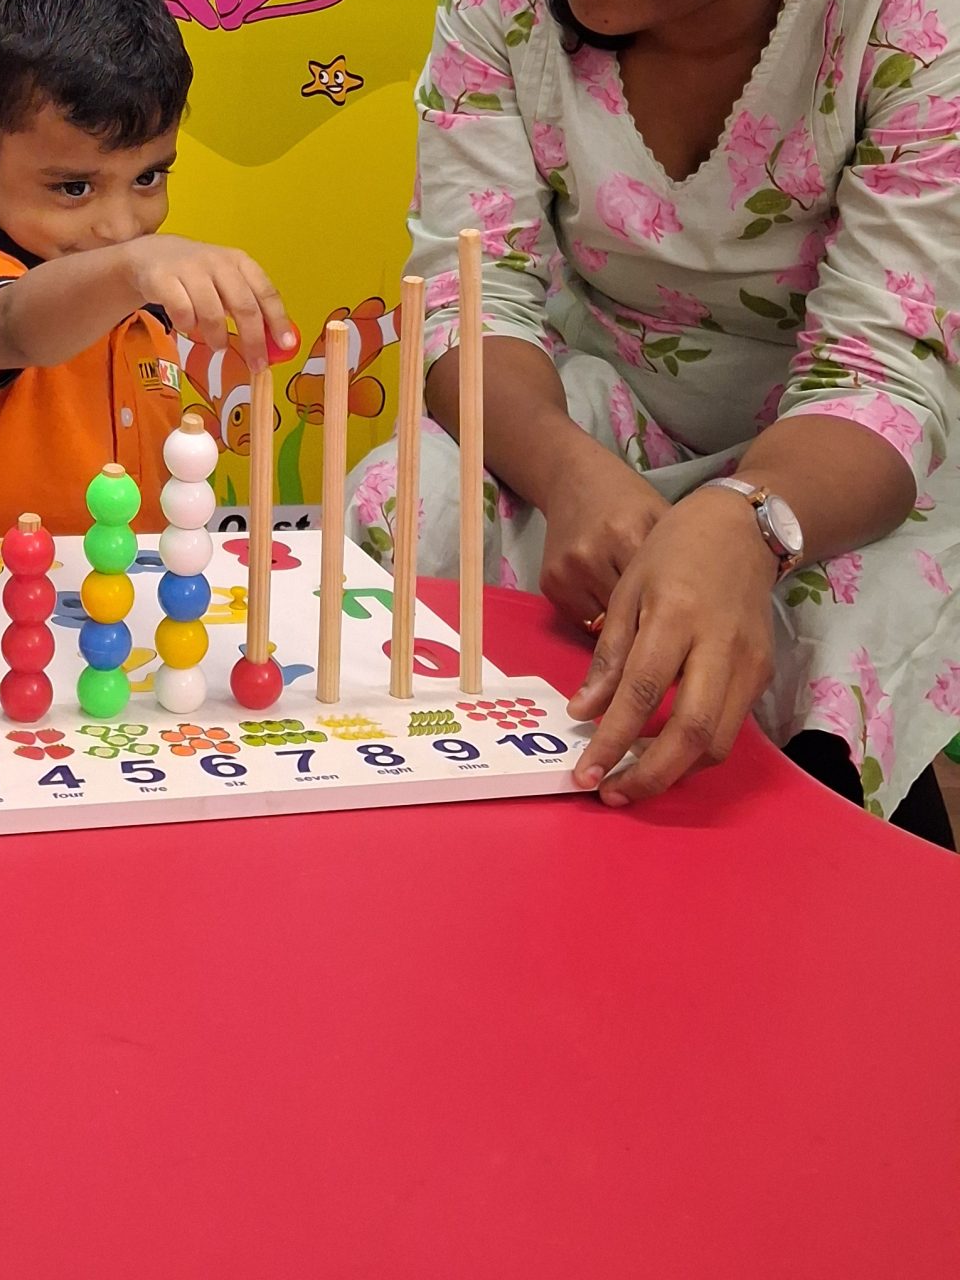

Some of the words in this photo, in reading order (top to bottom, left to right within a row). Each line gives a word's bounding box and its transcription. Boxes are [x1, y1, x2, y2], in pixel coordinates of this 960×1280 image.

[38, 764, 86, 789] 4
[120, 759, 166, 784] 5
[199, 754, 248, 778] 6
[274, 749, 316, 773] 7
[356, 743, 406, 767] 8
[432, 738, 480, 762] 9
[495, 732, 568, 756] 10
[52, 790, 86, 800] four
[139, 785, 168, 794] five
[224, 780, 248, 788] six
[294, 773, 340, 783] seven
[376, 765, 415, 776] eight
[457, 762, 490, 771] nine
[538, 756, 564, 765] ten
